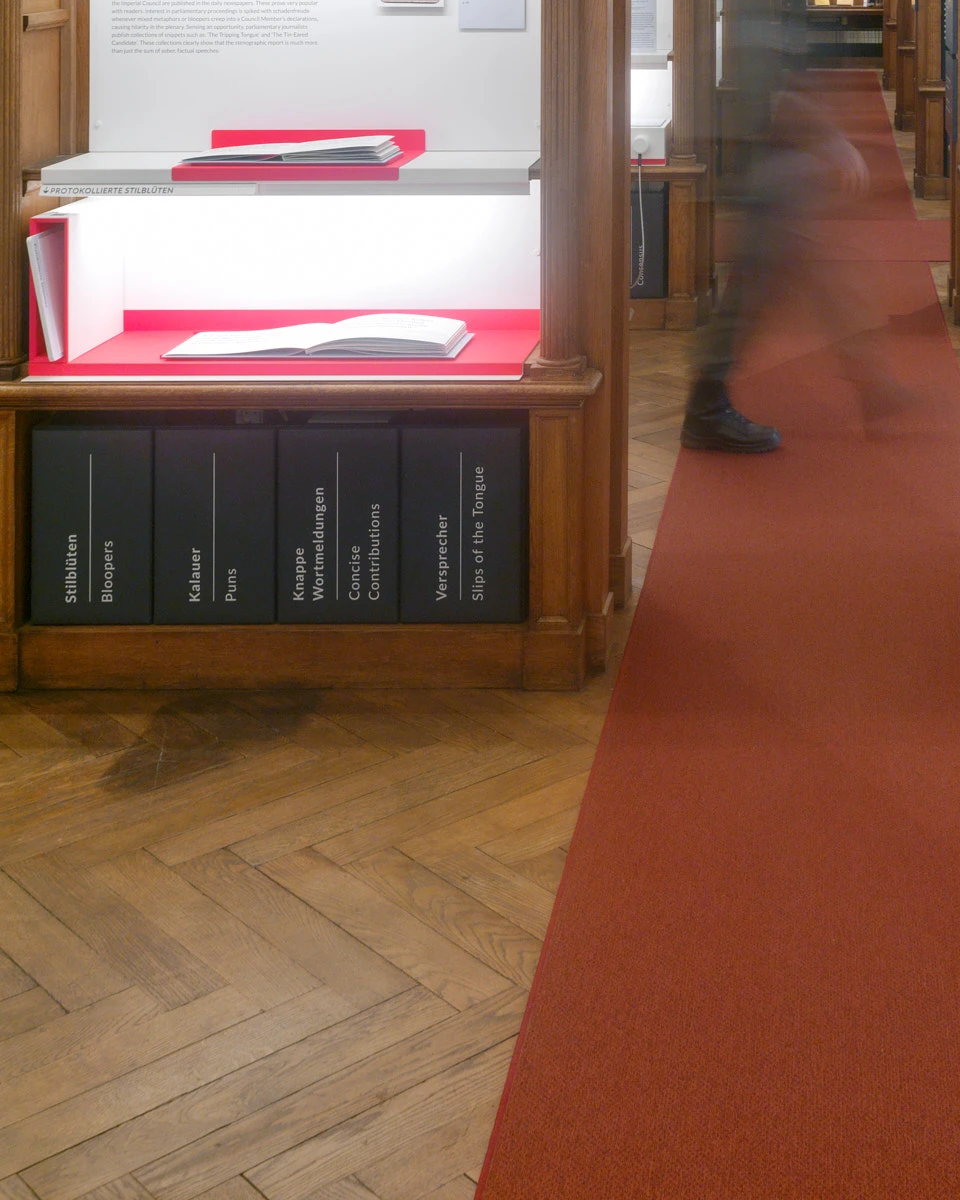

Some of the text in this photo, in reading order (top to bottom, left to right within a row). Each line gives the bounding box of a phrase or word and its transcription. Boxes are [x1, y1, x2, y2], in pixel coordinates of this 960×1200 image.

[124, 186, 174, 194] STILBLÜTEN
[313, 487, 326, 601] Wortmeldungen
[368, 503, 380, 601] Contributions
[436, 514, 449, 601] Versprecher
[472, 466, 486, 601] Slips of the Tongue
[65, 534, 78, 603] Stilblüten
[101, 540, 115, 603] Bloopers
[189, 547, 201, 602] Kalauer
[225, 568, 237, 602] Puns
[293, 547, 306, 601] Knappe
[349, 545, 360, 601] Concise
